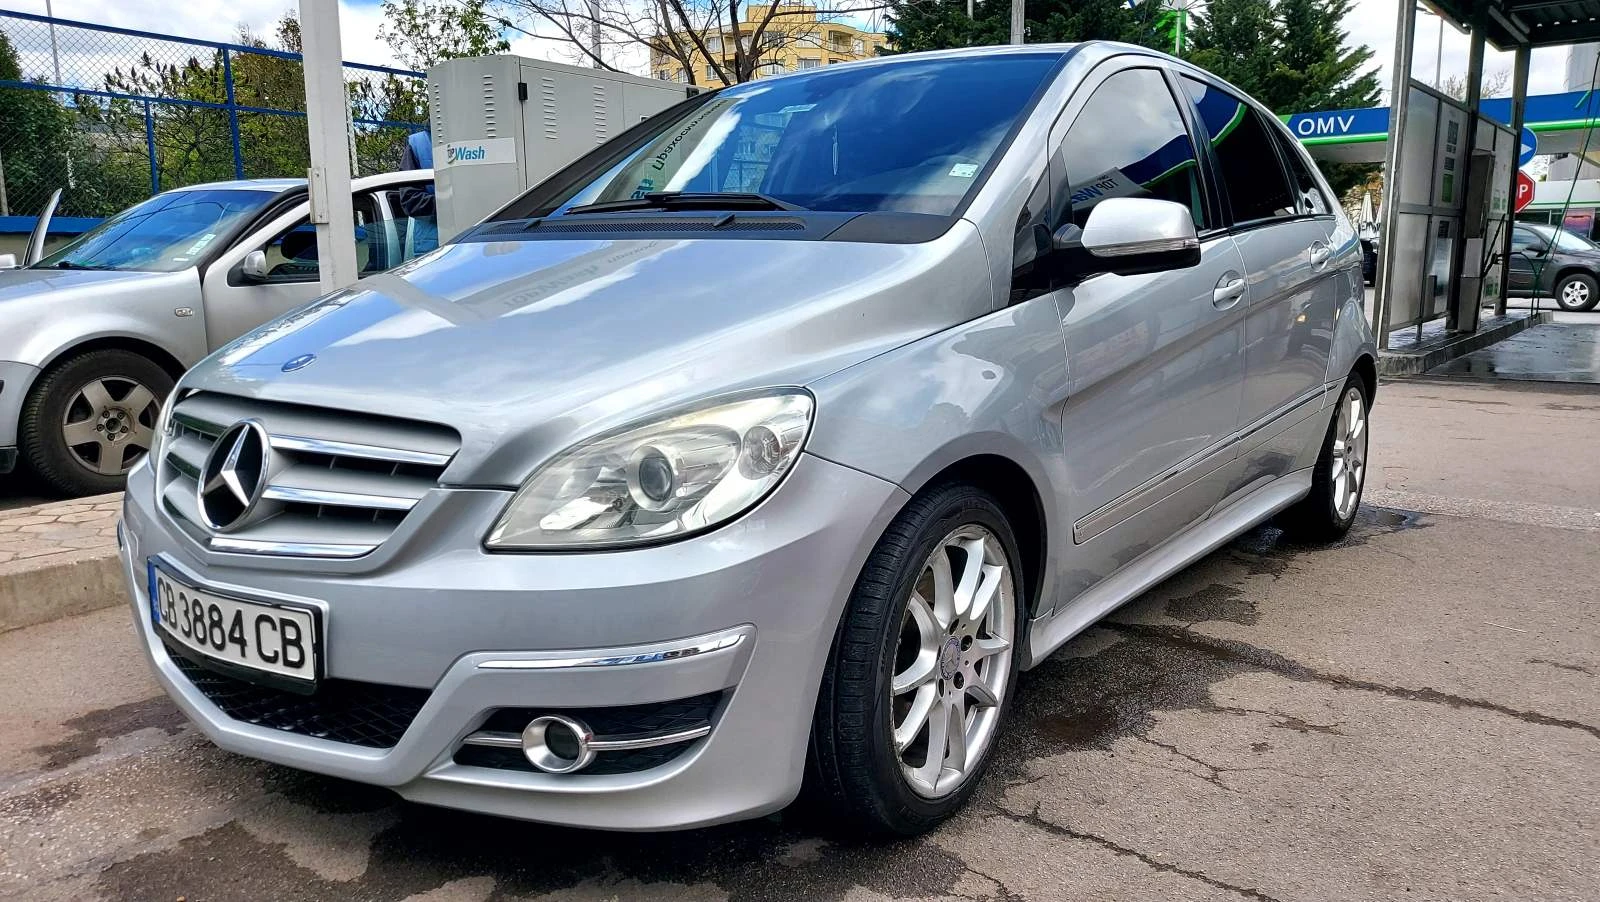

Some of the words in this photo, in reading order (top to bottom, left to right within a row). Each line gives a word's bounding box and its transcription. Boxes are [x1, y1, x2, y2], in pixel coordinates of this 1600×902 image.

[1298, 115, 1355, 136] OMV
[455, 146, 485, 161] Wash
[158, 577, 178, 630] CB
[179, 592, 248, 659] 3884
[255, 613, 306, 670] CB
